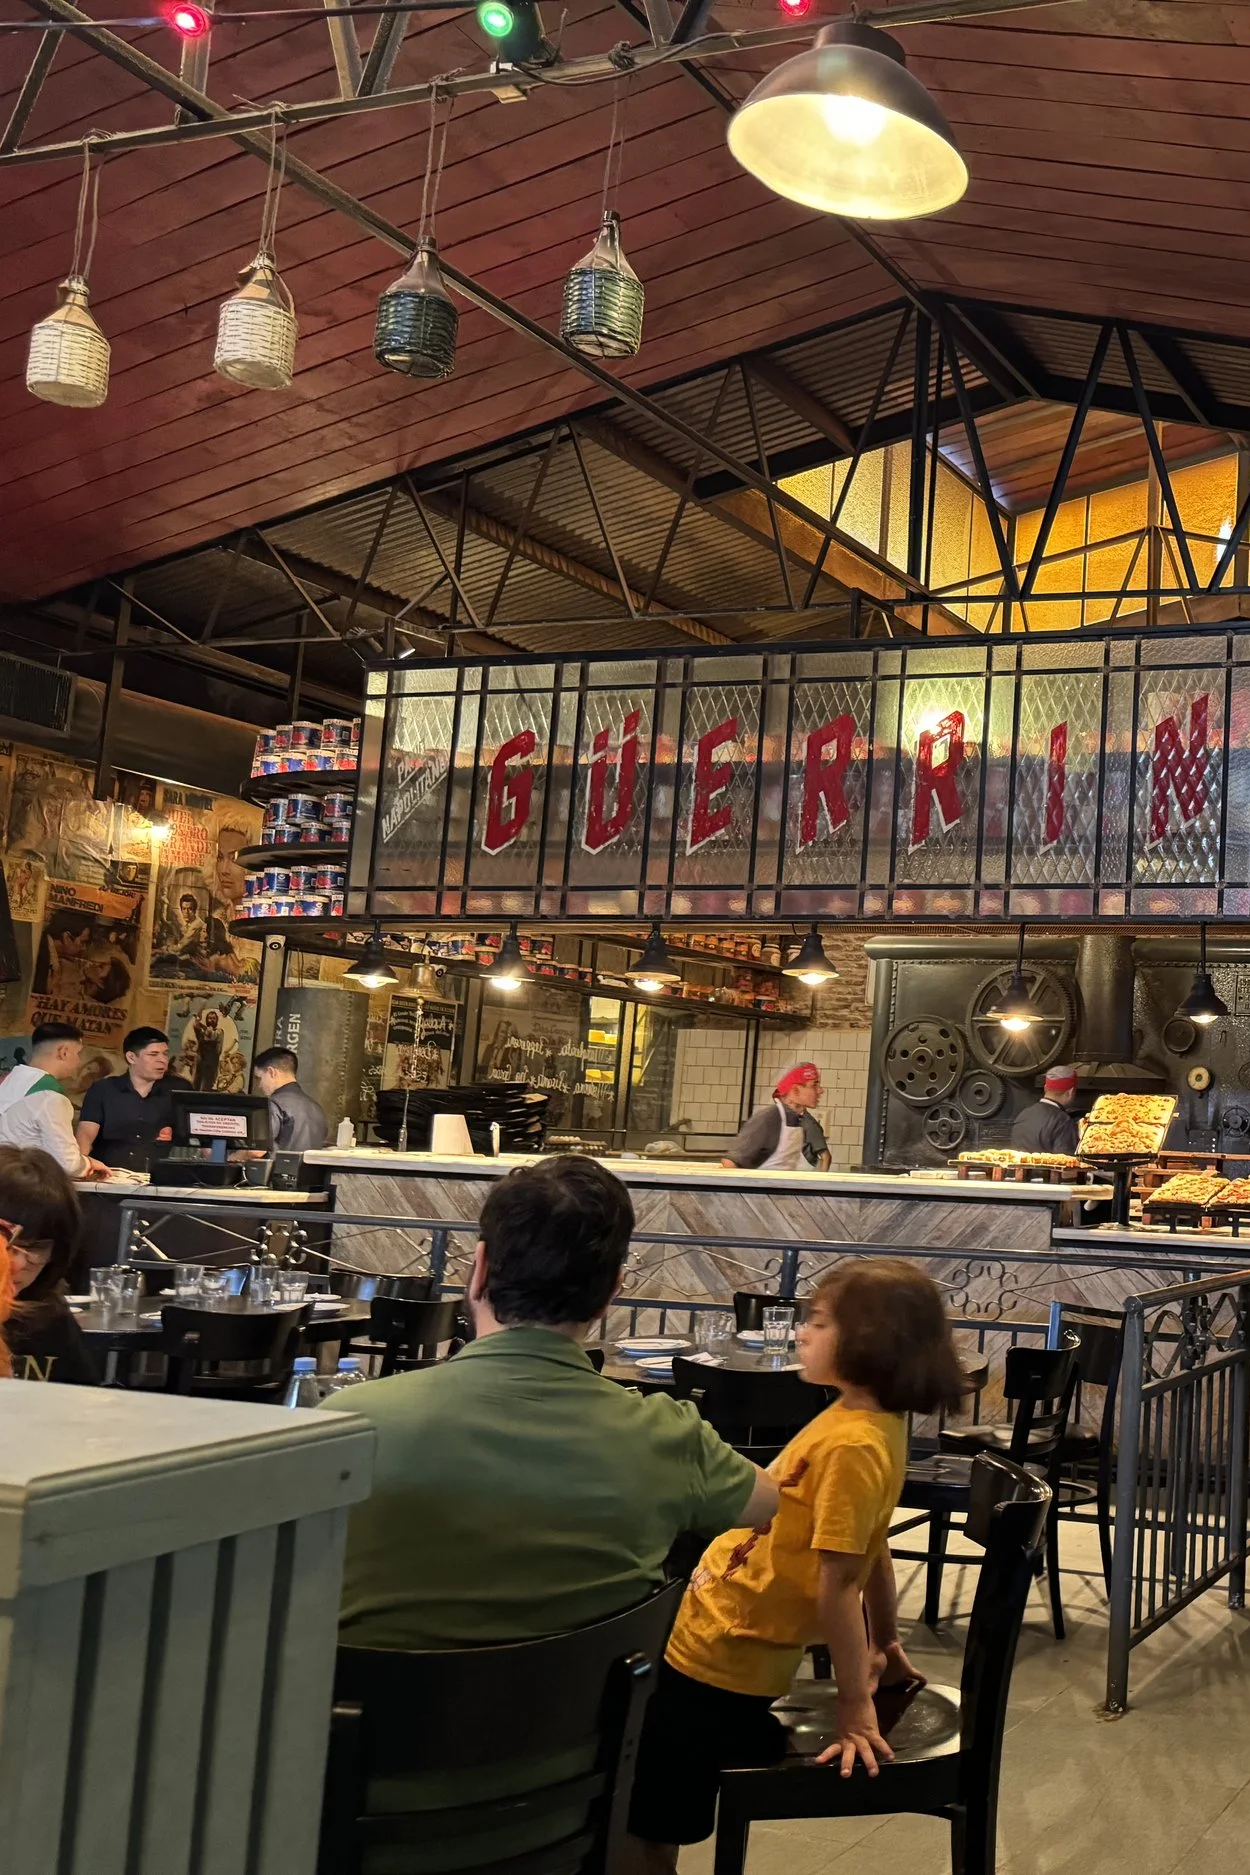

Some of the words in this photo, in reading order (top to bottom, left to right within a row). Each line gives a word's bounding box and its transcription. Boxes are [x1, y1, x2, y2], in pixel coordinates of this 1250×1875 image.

[481, 692, 1209, 856] GÜERRIN
[162, 837, 213, 855] RANDE
[50, 884, 77, 897] NINO
[274, 1016, 284, 1048] TRA
[286, 1013, 301, 1053] RGEN
